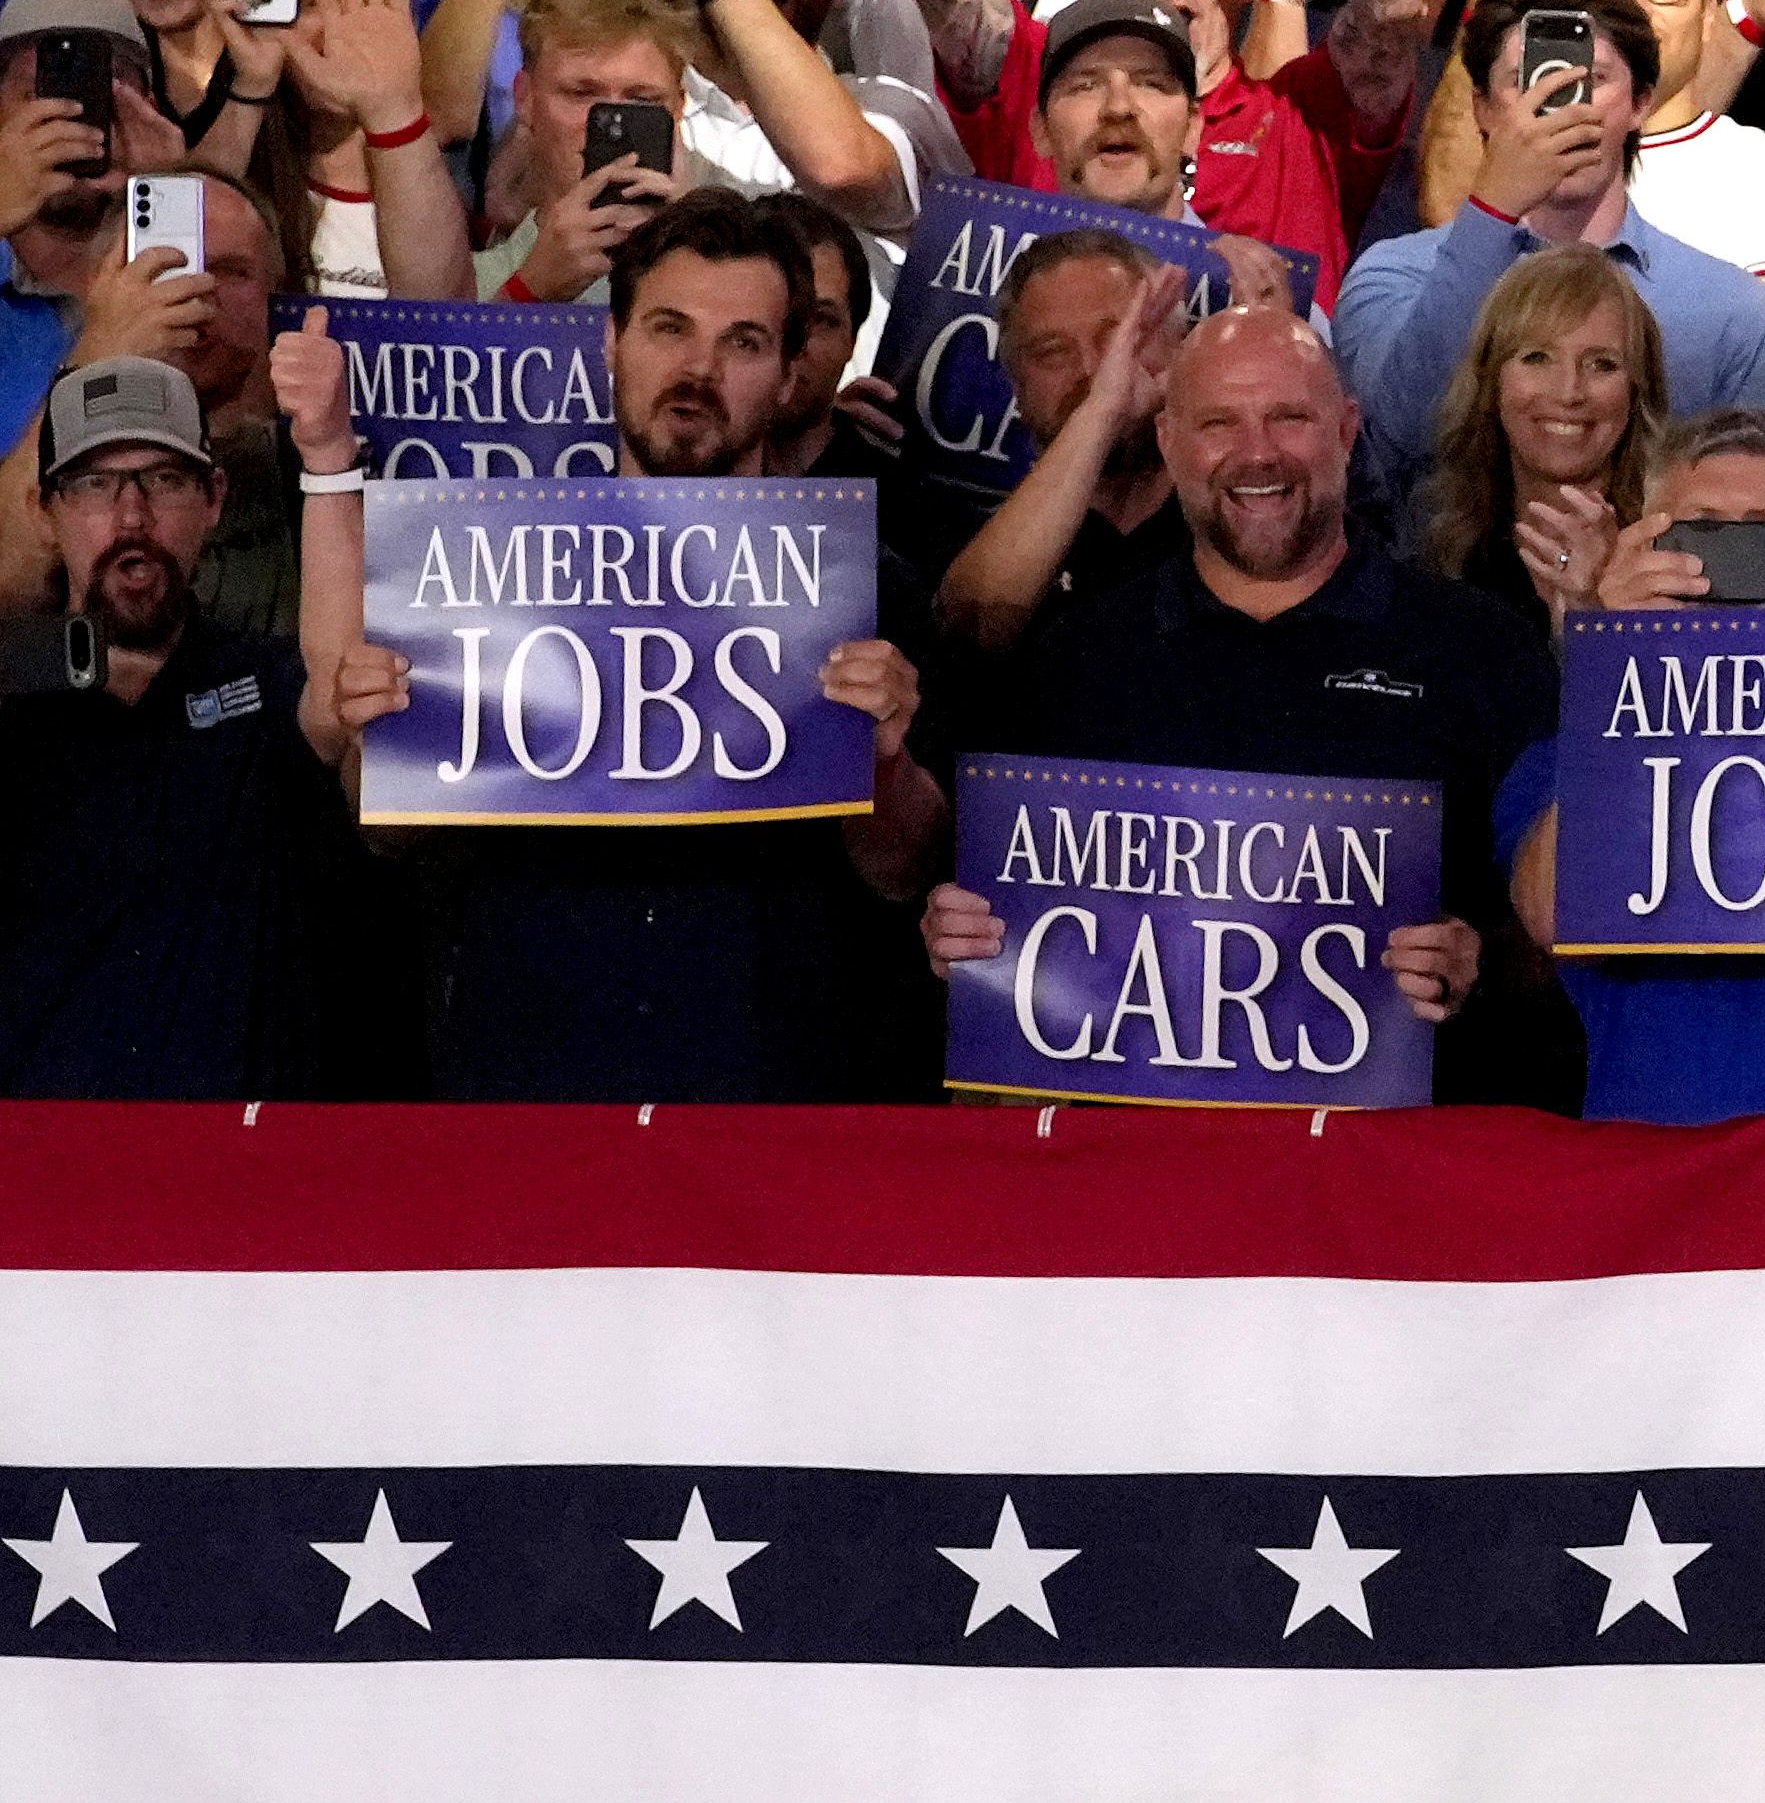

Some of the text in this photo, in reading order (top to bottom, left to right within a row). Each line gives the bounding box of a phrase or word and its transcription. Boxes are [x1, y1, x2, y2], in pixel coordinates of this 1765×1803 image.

[344, 341, 617, 425] MERICA
[409, 524, 827, 609] AMERICAN
[436, 624, 788, 783] JOBS
[996, 804, 1392, 908] AMERICAN
[1013, 905, 1370, 1075] CARS
